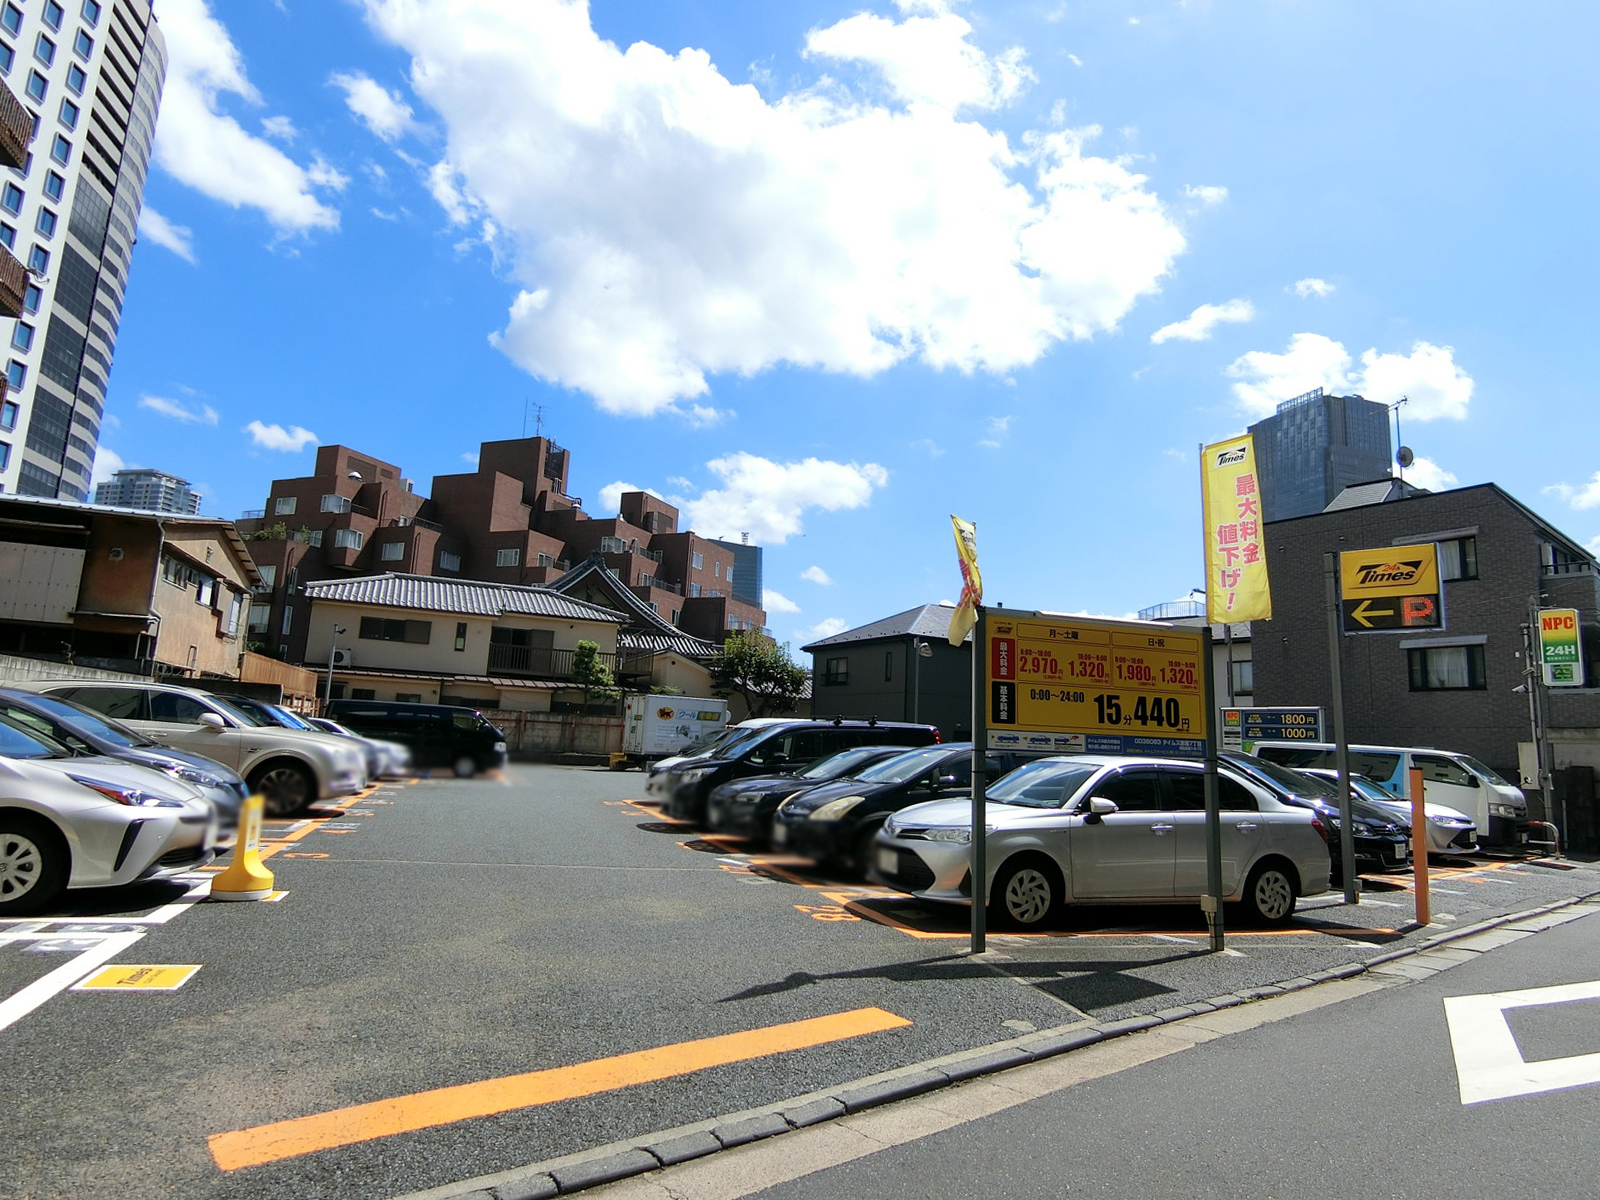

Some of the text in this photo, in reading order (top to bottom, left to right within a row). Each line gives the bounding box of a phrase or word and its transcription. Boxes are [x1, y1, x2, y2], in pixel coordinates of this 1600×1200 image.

[1217, 449, 1246, 466] Times
[1236, 474, 1260, 565] 最大料金
[1356, 566, 1417, 585] Times
[1403, 597, 1434, 626] P
[1542, 616, 1574, 631] NPC
[1000, 642, 1008, 676] 最大料金
[1545, 645, 1576, 656] 24H
[999, 685, 1008, 720] 基本料金
